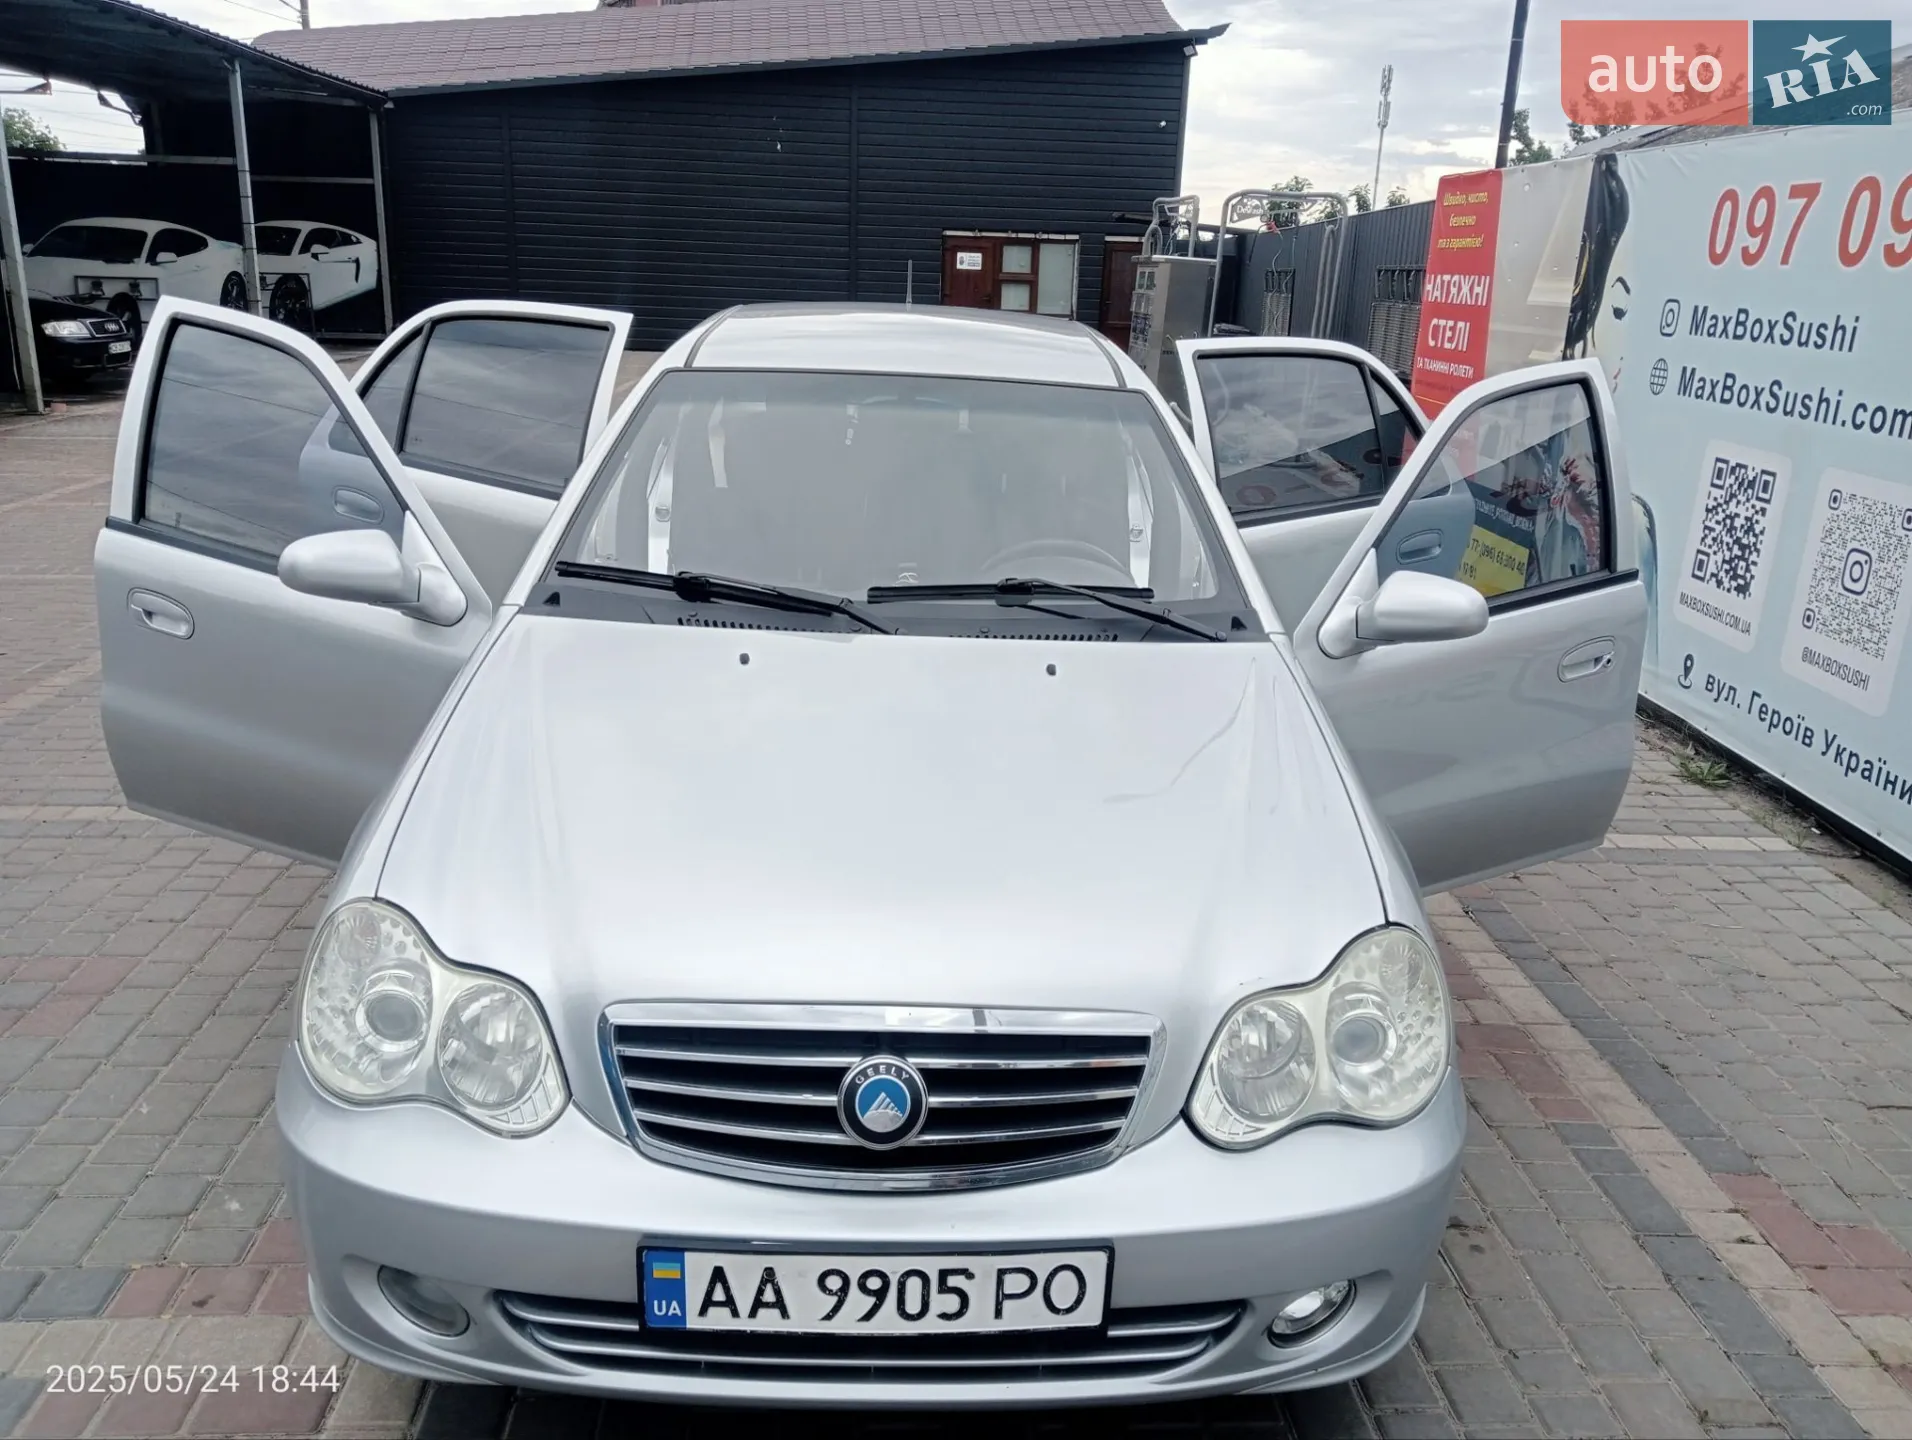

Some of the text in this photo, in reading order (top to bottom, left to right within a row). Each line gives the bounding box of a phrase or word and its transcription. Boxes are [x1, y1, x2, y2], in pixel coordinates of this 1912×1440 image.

[1707, 182, 1823, 267] 097
[1425, 273, 1490, 306] НАТЯЖНІ
[1428, 318, 1470, 351] СТЕЛІ
[1689, 304, 1860, 352] MaxBoxSushi
[1677, 365, 1912, 441] MaxBoxSushi.com
[1679, 591, 1751, 636] MAXBOXSUSHI.COM.UA
[1801, 646, 1871, 691] @MAXBOXSUSHI
[1705, 673, 1912, 805] вул. Героїв України
[855, 1065, 910, 1084] GEELY
[653, 1299, 682, 1318] UA
[697, 1263, 1087, 1322] AA 9905 PO
